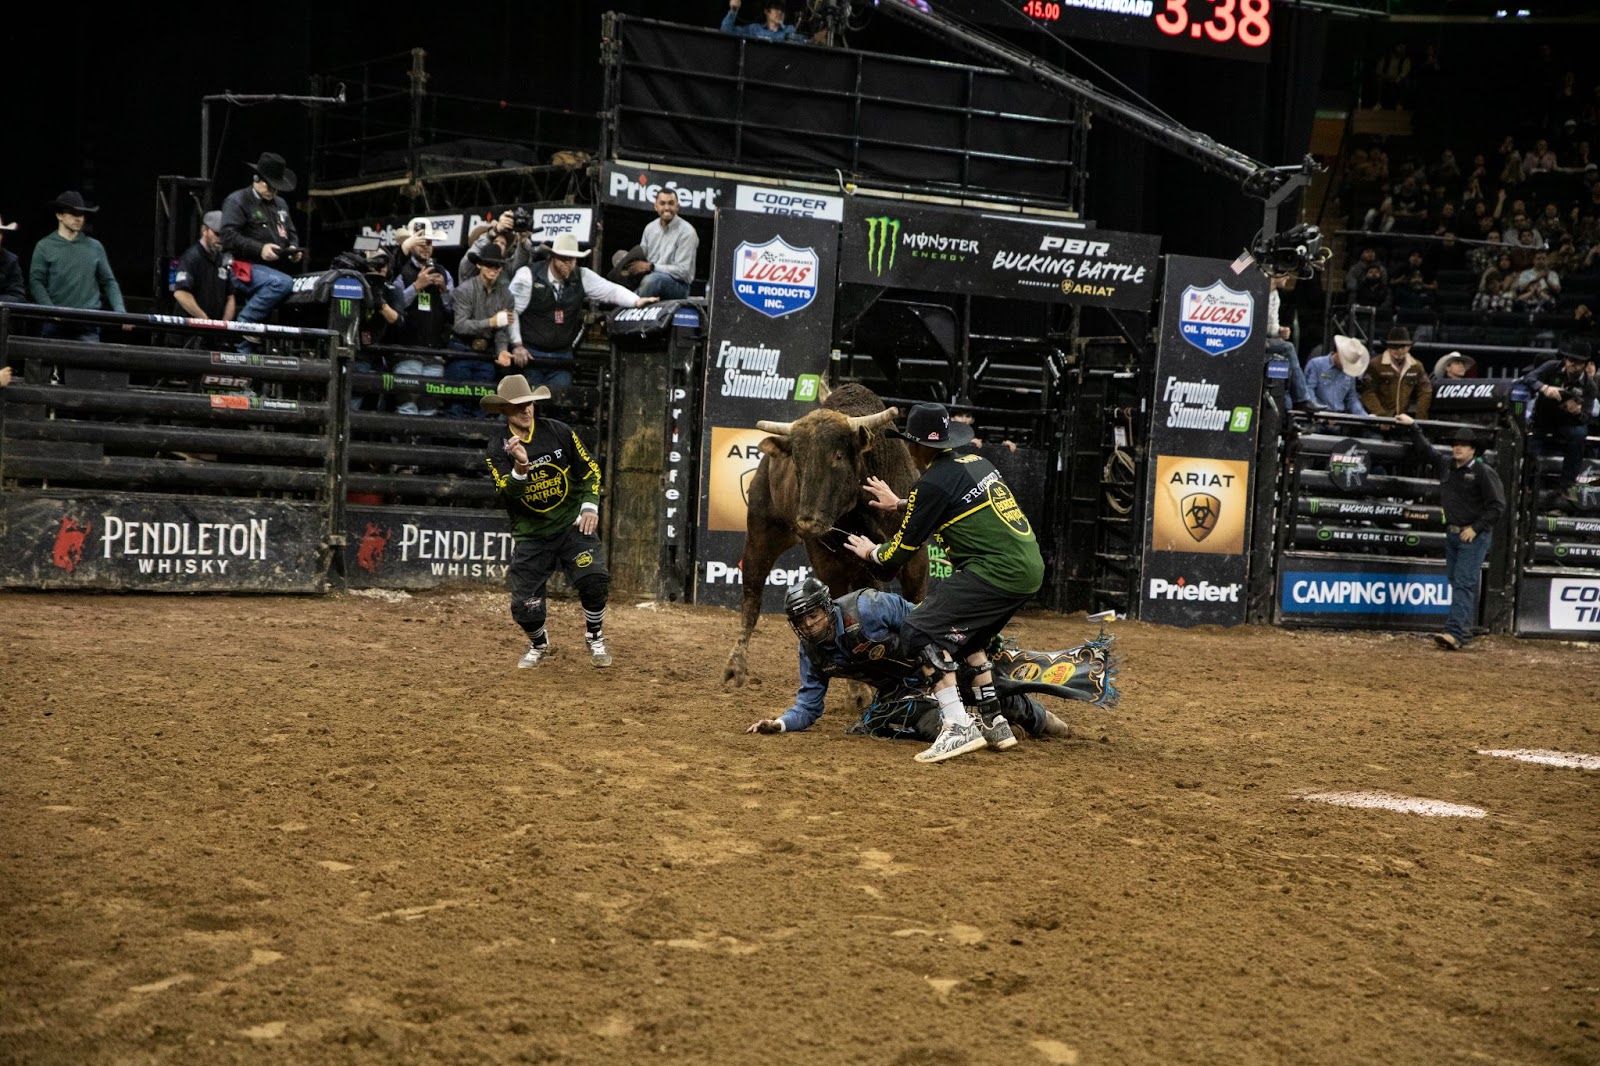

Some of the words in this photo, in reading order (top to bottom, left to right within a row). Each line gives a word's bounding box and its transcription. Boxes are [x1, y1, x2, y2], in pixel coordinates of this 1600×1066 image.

[1023, 0, 1060, 21] -15.00
[1155, 0, 1271, 47] 3.38
[752, 192, 827, 210] COOPER
[431, 219, 455, 231] OPER
[541, 213, 581, 224] COOPER
[902, 232, 979, 254] MONSTER
[1039, 235, 1110, 256] PBR
[911, 250, 966, 262] ENERGY
[743, 262, 811, 284] LUCAS
[992, 250, 1075, 277] BUCKING
[1077, 259, 1147, 284] BATTLE
[738, 284, 755, 295] OIL
[757, 286, 812, 299] PRODUCTS
[1072, 285, 1115, 297] ARIAT
[764, 299, 785, 309] INC.
[614, 308, 648, 321] LUCAS
[643, 306, 662, 320] OIL
[1188, 304, 1247, 324] LUCAS
[1184, 324, 1198, 334] OIL
[1200, 325, 1247, 338] PRODUCTS
[1206, 338, 1224, 347] INC.
[716, 340, 780, 375] Farming
[426, 383, 473, 396] Unleash
[474, 387, 495, 397] the
[721, 368, 795, 400] Simulator
[800, 378, 816, 397] 25
[1163, 376, 1220, 408] Farming
[1436, 385, 1474, 398] LUCAS
[1473, 384, 1494, 398] OIL
[1167, 402, 1231, 431] Simulator
[1234, 412, 1248, 428] 25
[664, 388, 687, 539] Priefert
[1170, 471, 1235, 488] ARIAT
[1340, 503, 1374, 514] BUCKING
[1374, 505, 1403, 516] BATTLE
[1575, 521, 1600, 531] BUCKIN
[100, 516, 268, 560] PENDLETON
[398, 523, 516, 561] PENDLET
[1334, 531, 1353, 540] NEW
[1357, 533, 1381, 541] YORK
[1384, 534, 1404, 542] CITY
[1569, 547, 1588, 555] NEW
[138, 559, 229, 573] WHISKY
[431, 562, 509, 577] WHISKY
[706, 560, 813, 586] Priert
[927, 562, 954, 580] the
[1149, 577, 1242, 603] Priefert
[1292, 580, 1386, 605] CAMPING
